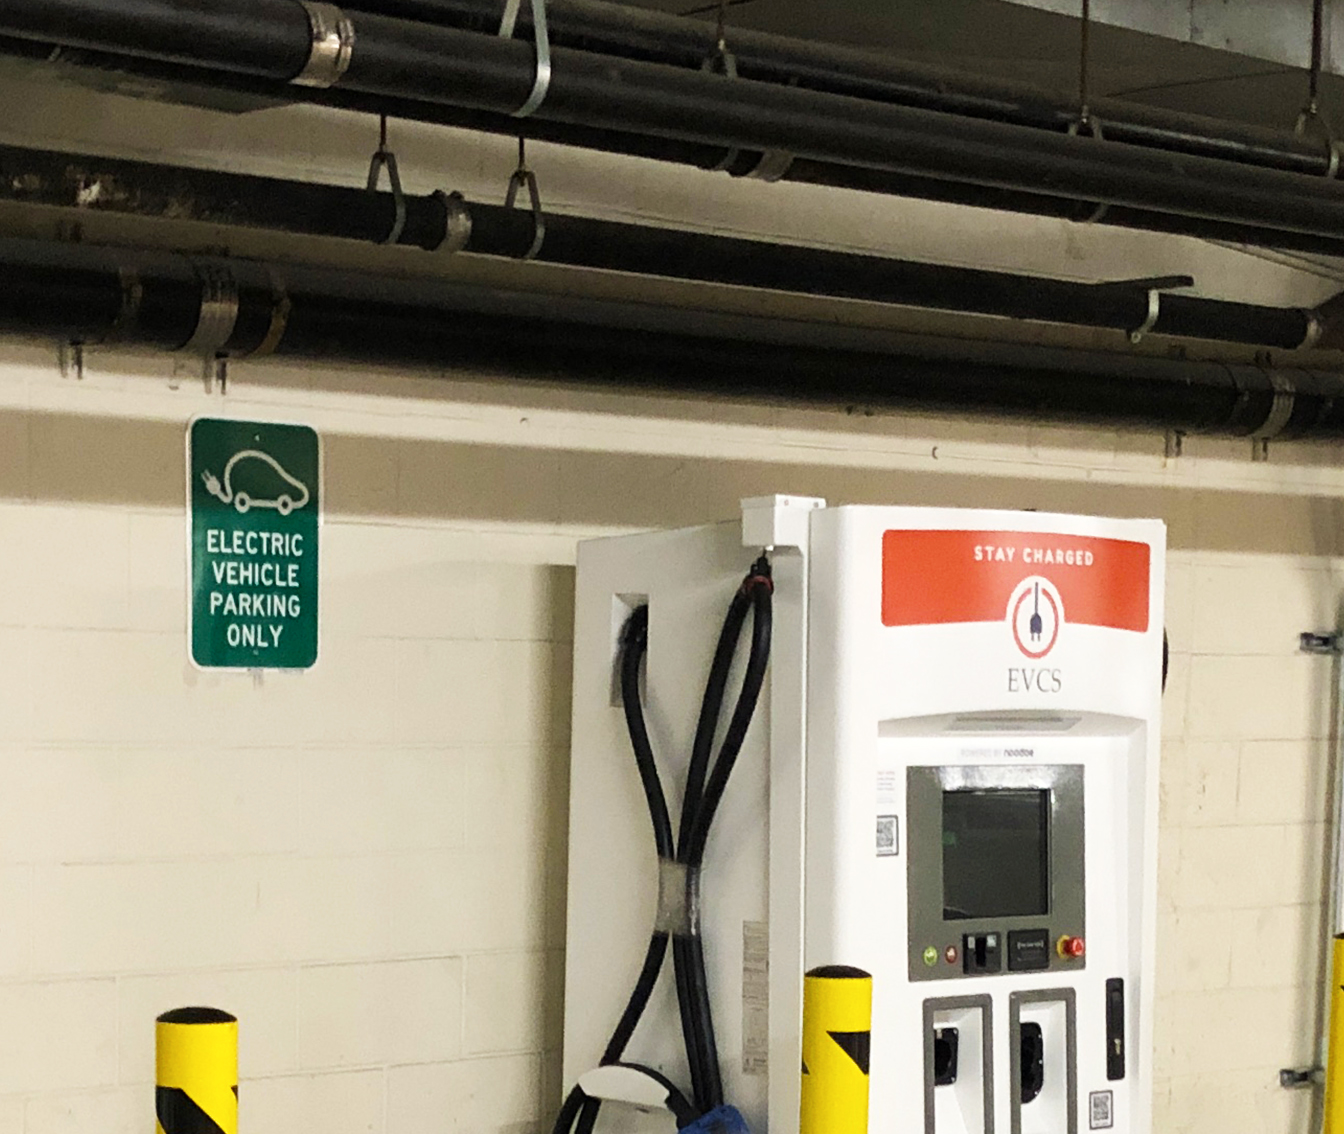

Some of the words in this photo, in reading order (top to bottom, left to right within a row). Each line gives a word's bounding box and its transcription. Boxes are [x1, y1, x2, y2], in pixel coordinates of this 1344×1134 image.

[206, 529, 304, 557] ELECTRIC
[973, 545, 1016, 563] STAY
[1022, 547, 1094, 566] CHARGED
[211, 560, 300, 587] VEHICLE
[209, 591, 301, 618] PARKING
[226, 623, 284, 648] ONLY
[1006, 667, 1063, 694] EVCS
